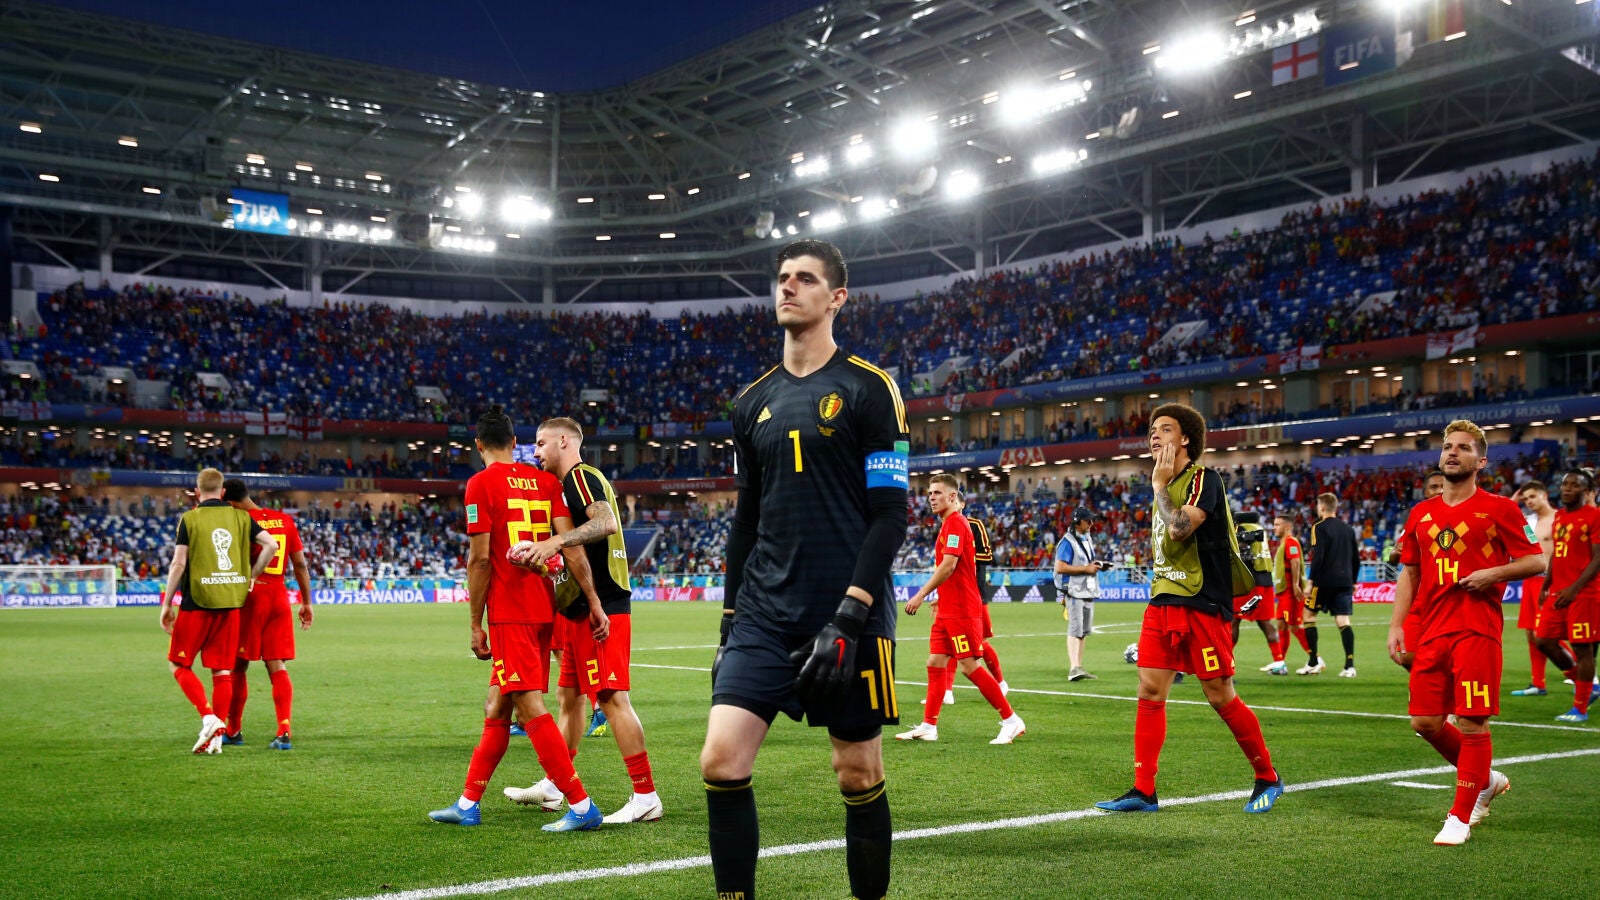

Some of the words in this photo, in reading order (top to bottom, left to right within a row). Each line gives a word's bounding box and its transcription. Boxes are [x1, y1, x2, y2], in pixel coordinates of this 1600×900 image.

[1334, 35, 1384, 67] FIFA
[241, 203, 280, 222] FIFA
[788, 429, 803, 473] 1
[507, 498, 551, 548] 22
[1555, 541, 1568, 558] 21
[201, 577, 232, 585] RUSSIA
[1436, 558, 1459, 585] 14
[108, 595, 160, 605] YUNDAI
[370, 591, 426, 603] WANDA
[1121, 587, 1146, 600] FIFA
[1572, 623, 1590, 639] 21
[951, 635, 970, 654] 16
[1202, 646, 1220, 672] 6
[586, 659, 600, 686] 2
[860, 669, 879, 710] 1
[1461, 680, 1491, 709] 14
